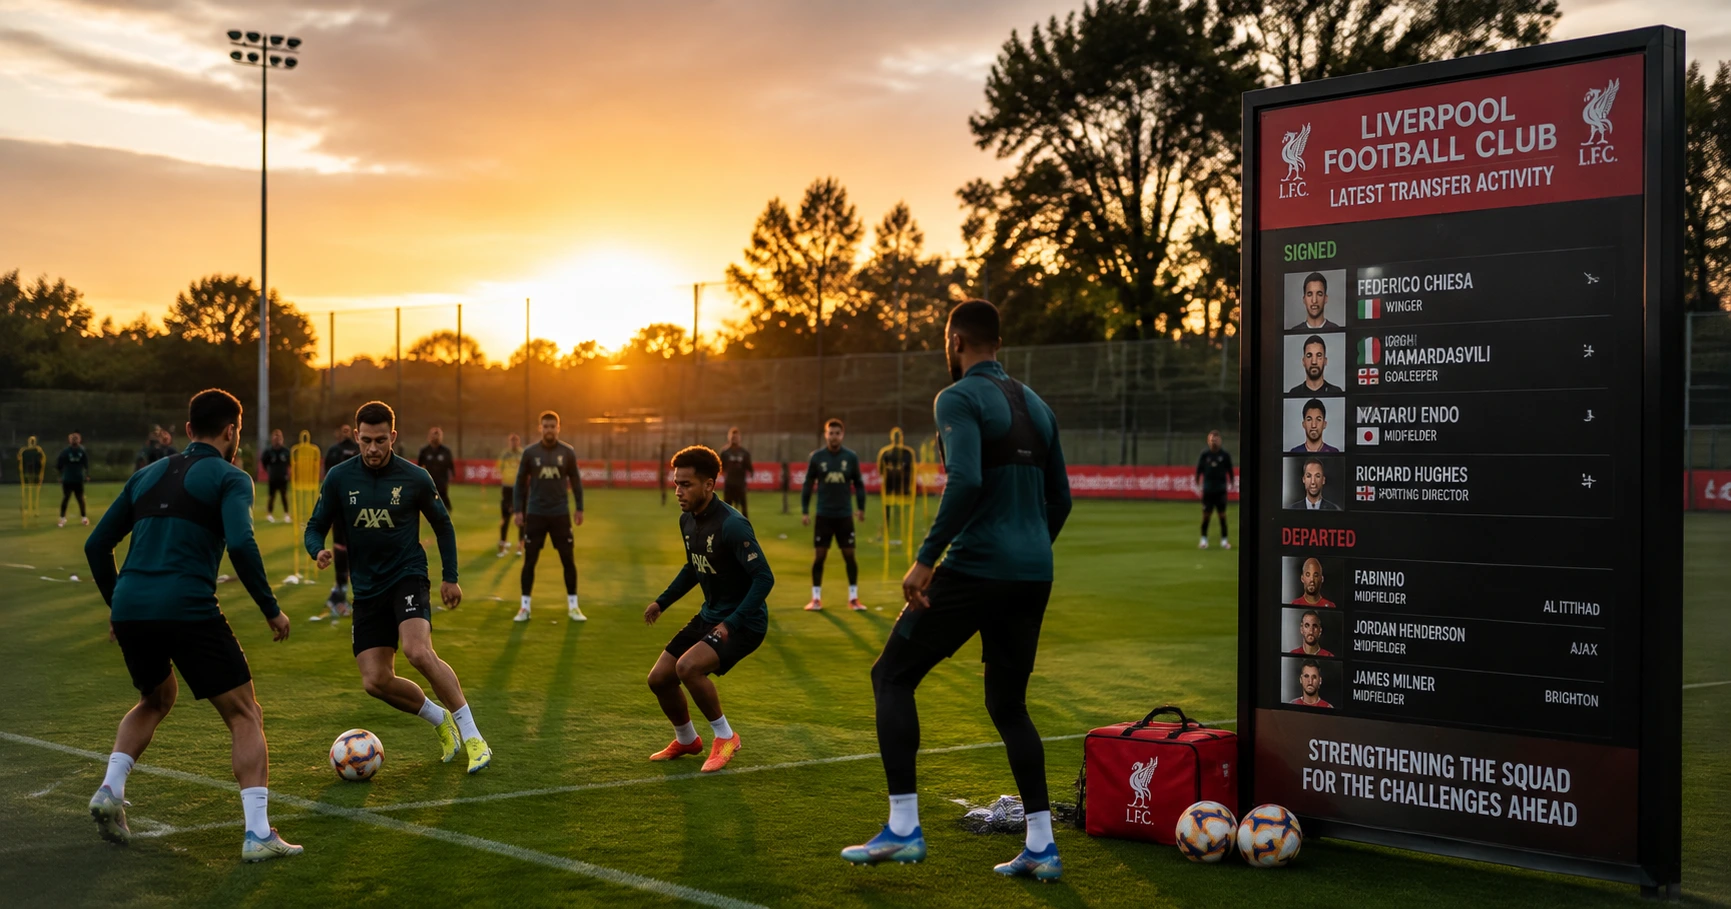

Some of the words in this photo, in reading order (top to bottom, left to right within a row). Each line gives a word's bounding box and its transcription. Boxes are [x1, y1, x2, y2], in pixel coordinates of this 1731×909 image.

[1361, 96, 1516, 139] LIVERPOOL
[1325, 135, 1464, 174] FOOTBALL
[1476, 124, 1556, 157] CLUB
[1579, 144, 1619, 166] L.F.C.
[1279, 182, 1309, 199] L.F.C.
[1331, 184, 1384, 207] LATEST
[1389, 175, 1471, 201] TRANSFER
[1476, 165, 1554, 192] ACTIVITY
[1285, 241, 1336, 261] SIGNED
[1358, 275, 1420, 295] FEDERICO
[1425, 273, 1473, 291] CHIESA
[1386, 300, 1422, 312] WINGER
[1385, 346, 1490, 365] MAMARDASVILI
[1422, 406, 1459, 423] ENDO
[1385, 430, 1436, 441] MIDFIELDER
[1357, 466, 1411, 481] RICHARD
[1415, 467, 1467, 482] HUGHES
[1422, 489, 1468, 501] DIRECTOR
[353, 508, 395, 528] AXA
[1283, 528, 1355, 547] DEPARTED
[1355, 570, 1404, 586] FABINHO
[1355, 591, 1406, 604] MIDFIELDER
[1544, 601, 1557, 612] AL
[1560, 601, 1600, 615] ITTIHAD
[1354, 620, 1396, 636] JORDAN
[1400, 623, 1465, 642] HENDERSON
[1570, 642, 1597, 655] AJAX
[1353, 671, 1389, 686] JAMES
[1393, 674, 1434, 691] MILNER
[1353, 689, 1404, 704] MIDFIELDER
[1546, 690, 1598, 707] BRIGHTON
[1309, 739, 1454, 778] STRENGTHENING
[1460, 757, 1495, 783] THE
[1502, 762, 1570, 792] SQUAD
[1303, 768, 1336, 793] FOR
[1341, 773, 1374, 798] THE
[1380, 776, 1503, 816] CHALLENGES
[1508, 795, 1577, 826] AHEAD
[1126, 807, 1154, 825] L.F.C.
